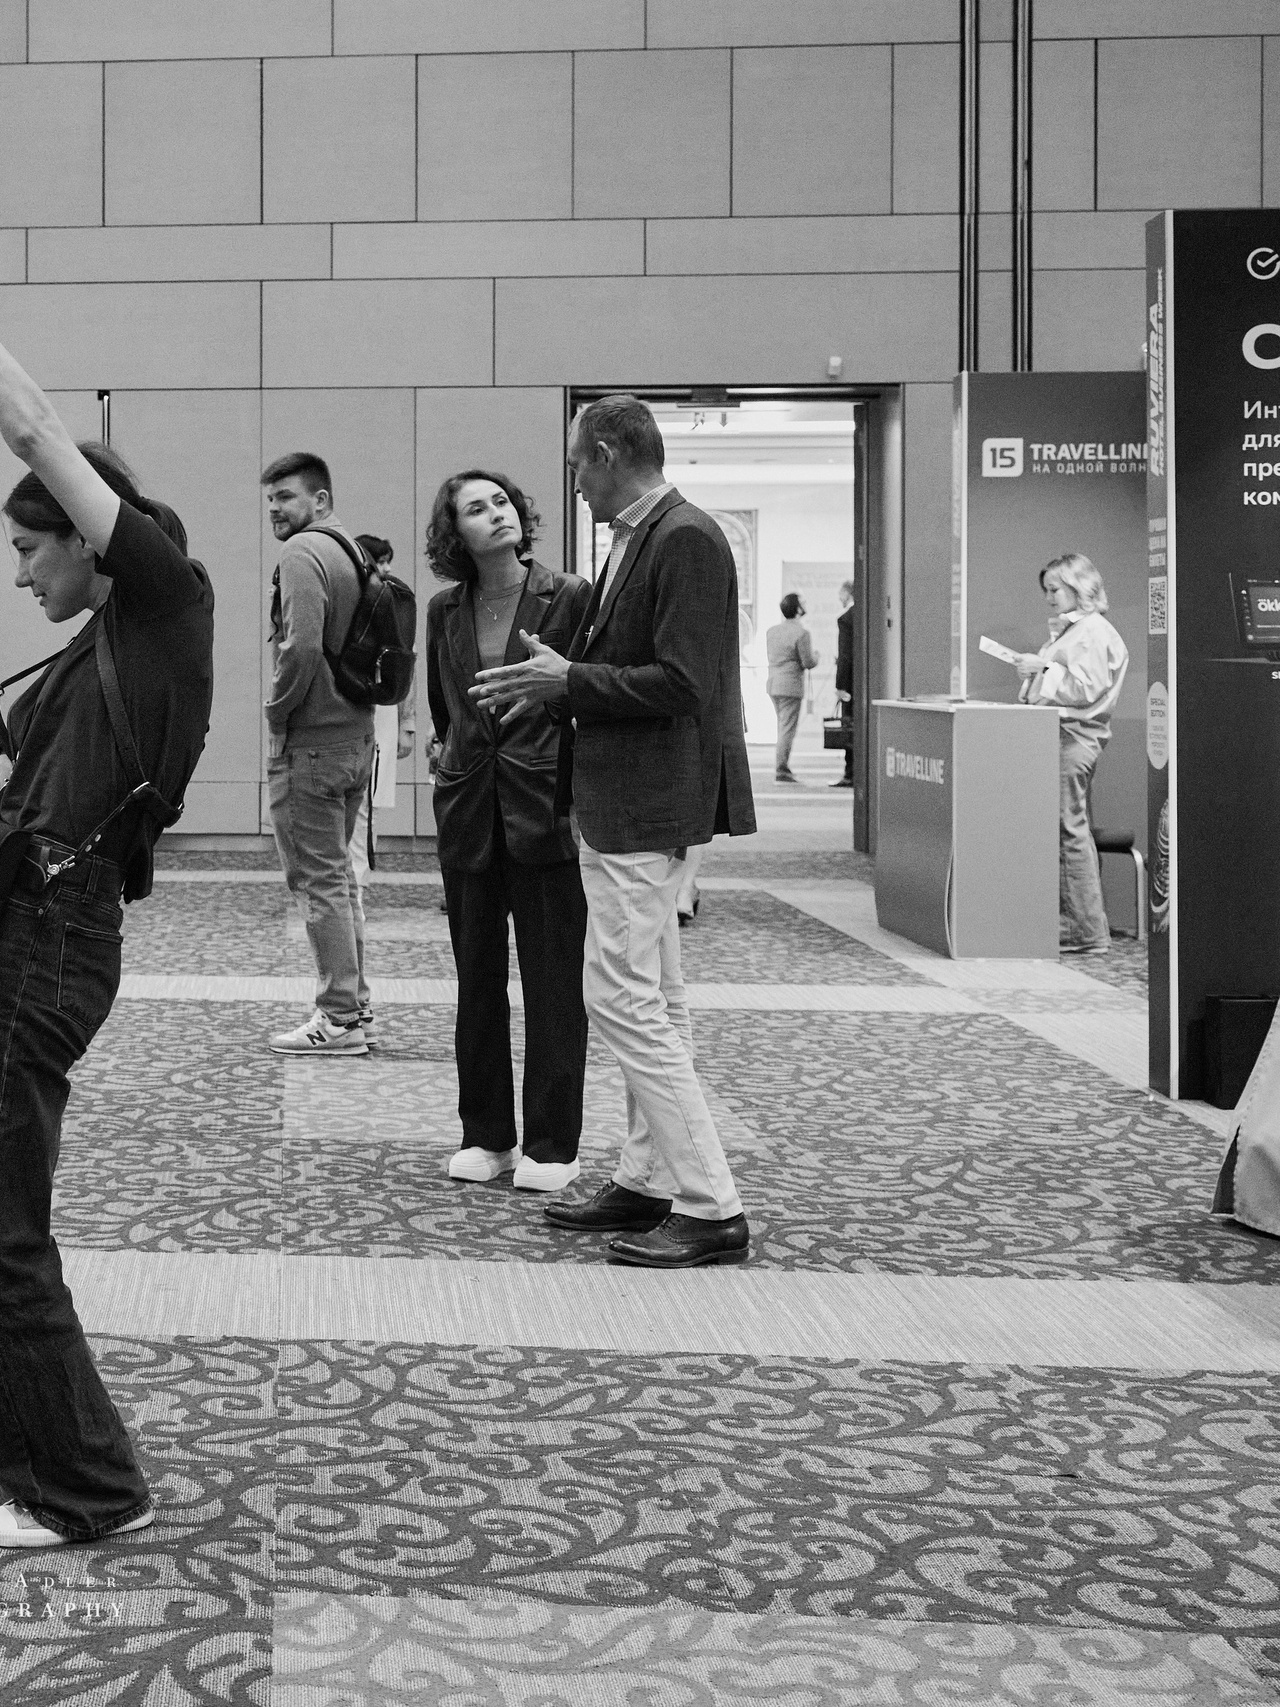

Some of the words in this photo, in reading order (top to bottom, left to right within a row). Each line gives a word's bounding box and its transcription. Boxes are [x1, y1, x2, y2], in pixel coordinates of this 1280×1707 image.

[1244, 401, 1280, 419] Ин
[990, 447, 1016, 469] 15
[1033, 463, 1051, 474] НА
[1056, 460, 1104, 475] ОДНОЙ
[305, 1029, 327, 1046] N
